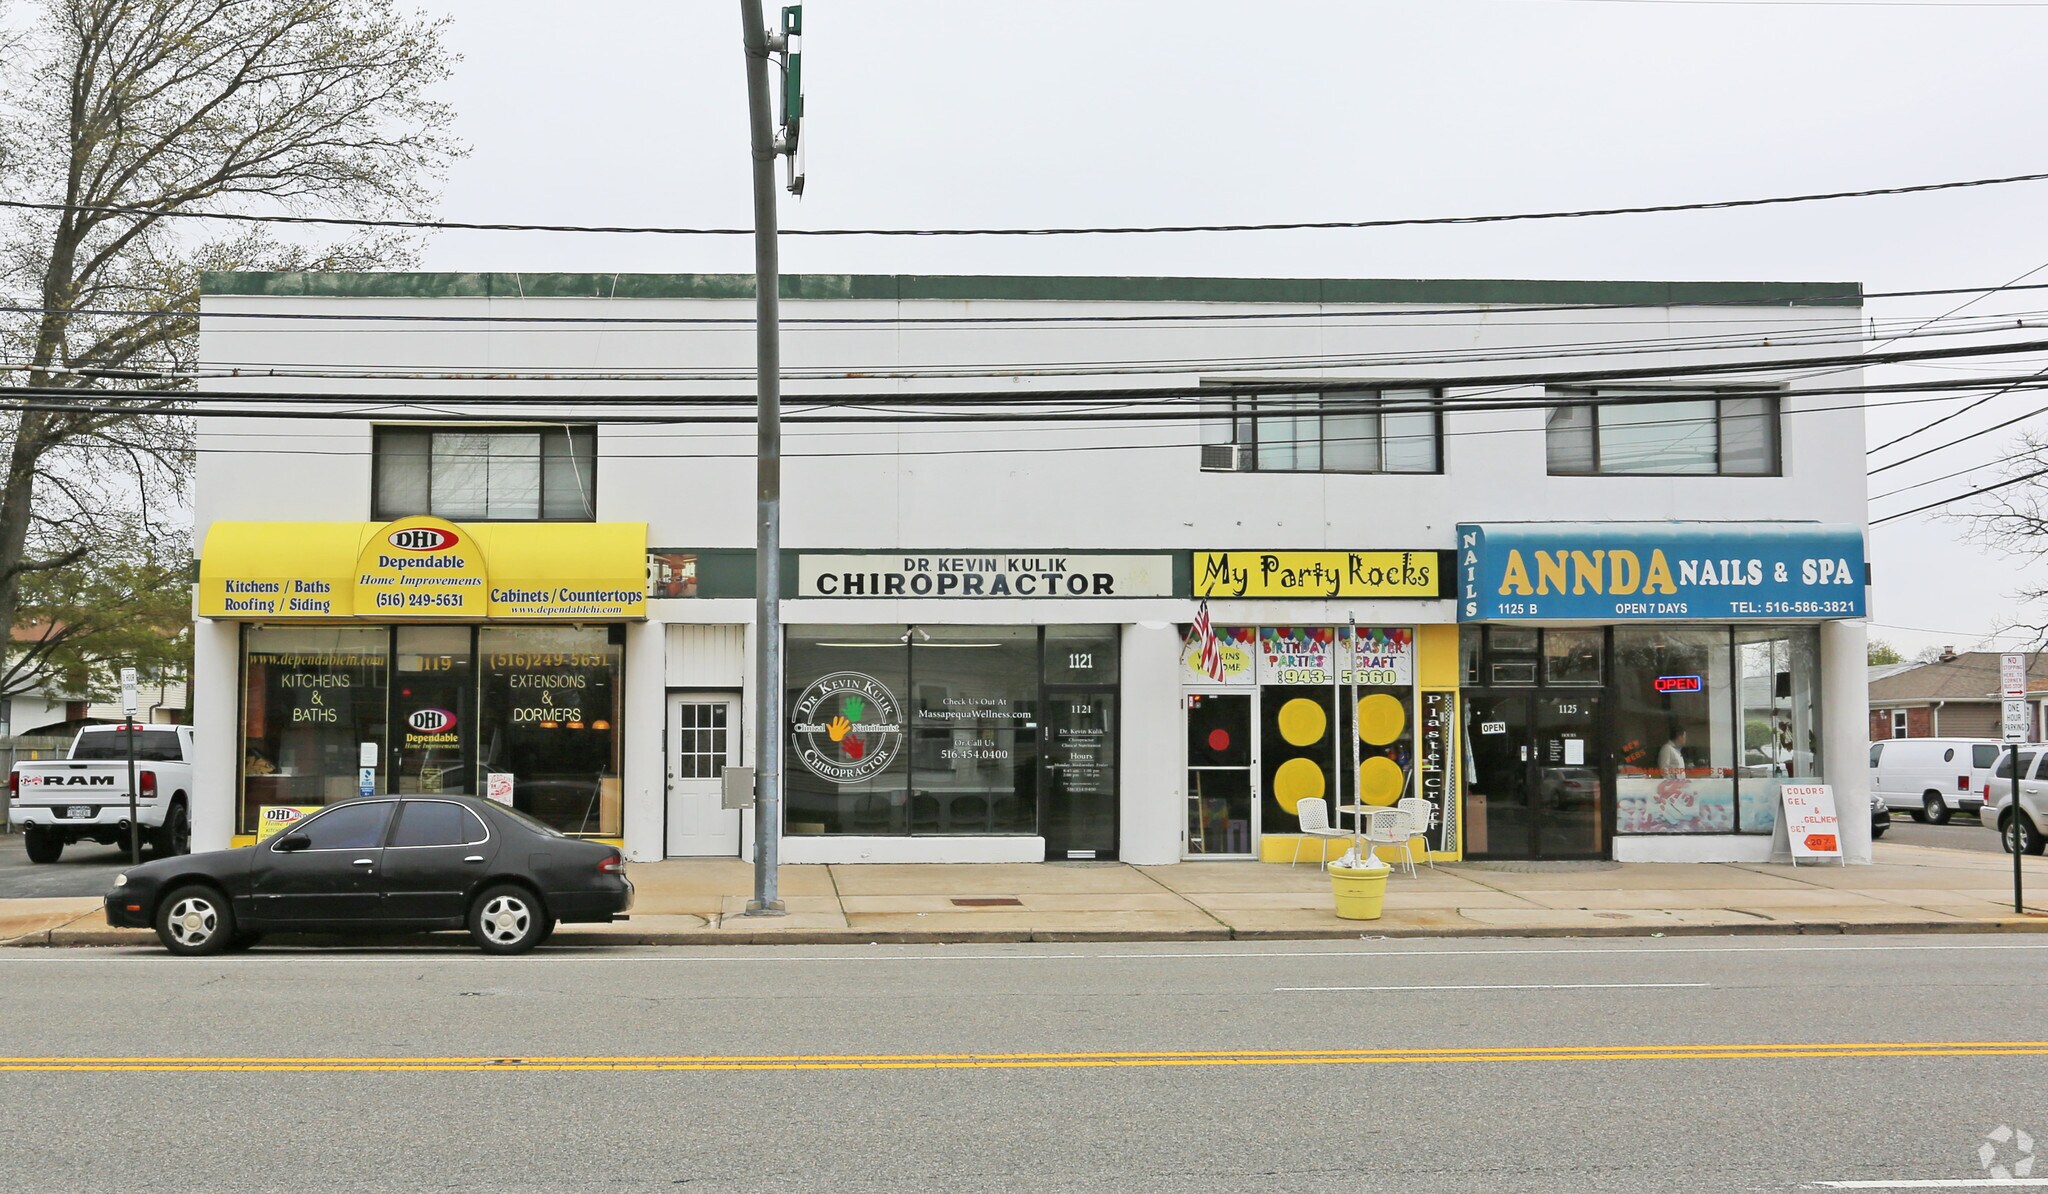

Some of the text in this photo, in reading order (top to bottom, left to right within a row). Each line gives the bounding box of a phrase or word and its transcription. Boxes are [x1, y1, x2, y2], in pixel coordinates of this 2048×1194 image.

[395, 530, 438, 548] DHI
[378, 555, 465, 571] Dependable
[904, 558, 1067, 572] DR. KEVIN KULIK
[1200, 552, 1430, 598] My Party Rocks
[1463, 532, 1478, 617] NAILS
[1498, 549, 1678, 596] ANNDA
[1679, 558, 1854, 586] NAILS & SPA
[225, 580, 279, 593] Kitchens
[294, 580, 331, 593] Baths
[359, 575, 482, 587] Home Improvements
[816, 573, 1114, 595] CHIROPRACTOR
[376, 593, 463, 608] (516) 249-5631
[490, 588, 549, 603] Cabinets
[559, 588, 643, 605] Countertops
[225, 598, 275, 614] Roofing
[289, 598, 331, 614] Siding
[510, 605, 623, 615] www.dependablehi.com
[1498, 603, 1538, 615] 1125 B
[1615, 603, 1688, 614] OPEN 7 DAYS
[1730, 601, 1854, 613] TEL: 516-586-3821
[1263, 641, 1327, 654] BIRTHDAY
[1069, 653, 1093, 669] 1121
[1269, 655, 1324, 668] PARTIES
[281, 674, 350, 688] KITCHENS
[510, 674, 586, 688] EXTENSIONS
[1654, 678, 1698, 690] OPEN
[311, 690, 324, 706] &
[541, 690, 553, 706] &
[1071, 704, 1092, 714] 1121
[1559, 705, 1577, 714] 1125
[2007, 704, 2020, 712] ONE
[292, 708, 338, 722] BATHS
[413, 711, 443, 729] DHI
[513, 708, 582, 722] DORMERS
[918, 709, 1032, 721] MassapequaWellness.com
[1483, 724, 1504, 733] OPEN
[406, 733, 458, 744] Dependable
[941, 750, 1008, 759] 516.454.0400
[1070, 752, 1093, 760] Hours
[44, 776, 115, 786] RAM
[267, 810, 290, 820] DHI
